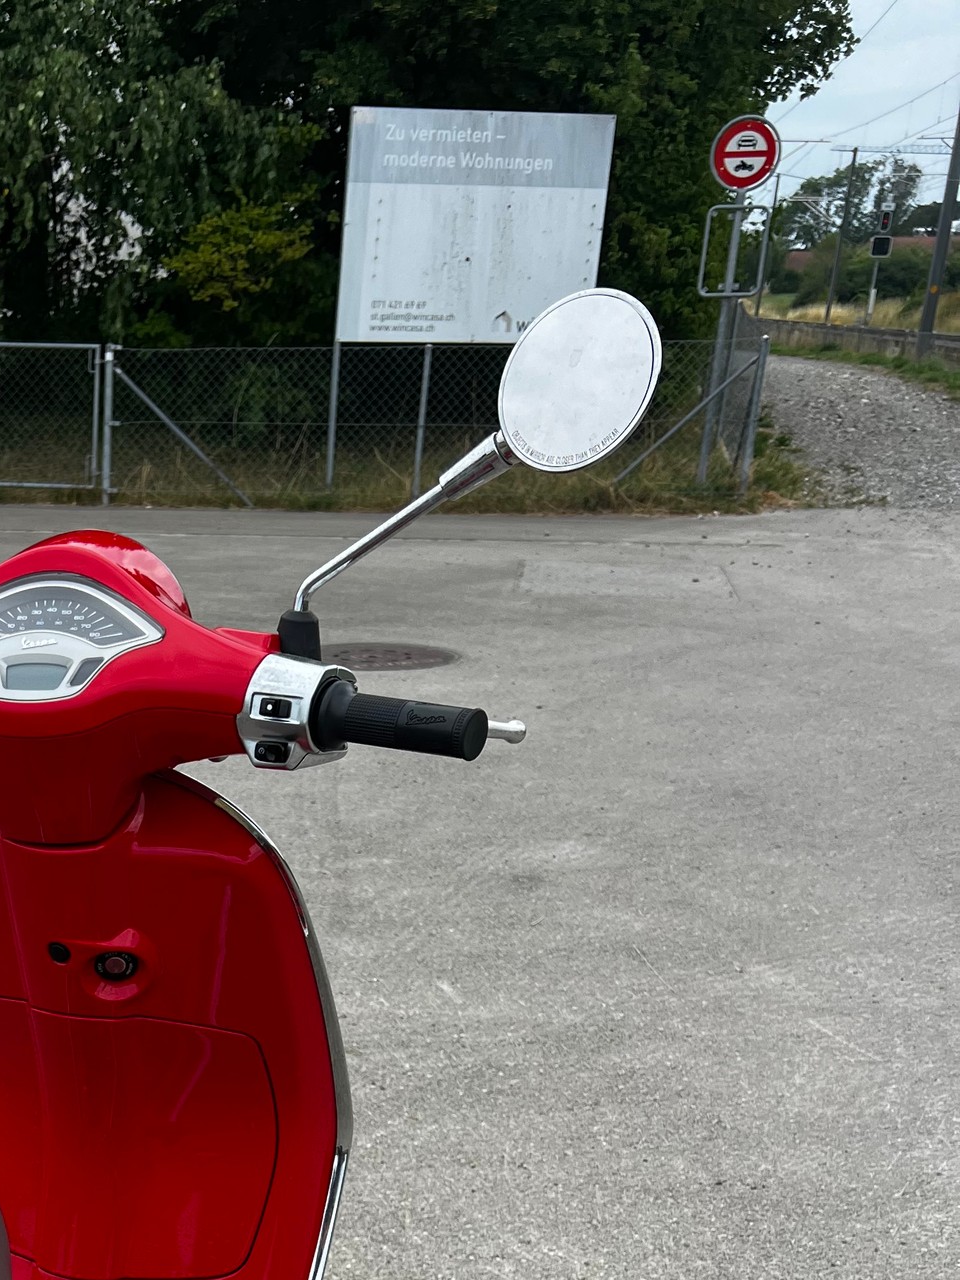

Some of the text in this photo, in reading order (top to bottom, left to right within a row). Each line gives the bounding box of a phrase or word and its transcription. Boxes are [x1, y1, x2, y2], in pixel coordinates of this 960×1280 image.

[385, 124, 404, 141] Zu
[409, 126, 491, 143] vermieten
[382, 151, 554, 174] moderne Wohnungen
[511, 430, 528, 449] OBJECTS
[530, 449, 546, 461] MIRROR
[546, 456, 555, 464] ARE
[555, 454, 575, 465] CLOSER
[575, 451, 589, 460] THAN
[588, 444, 601, 455] THEY
[601, 428, 620, 447] APPEAR
[21, 636, 58, 650] Vespa
[405, 709, 447, 726] Vespa
